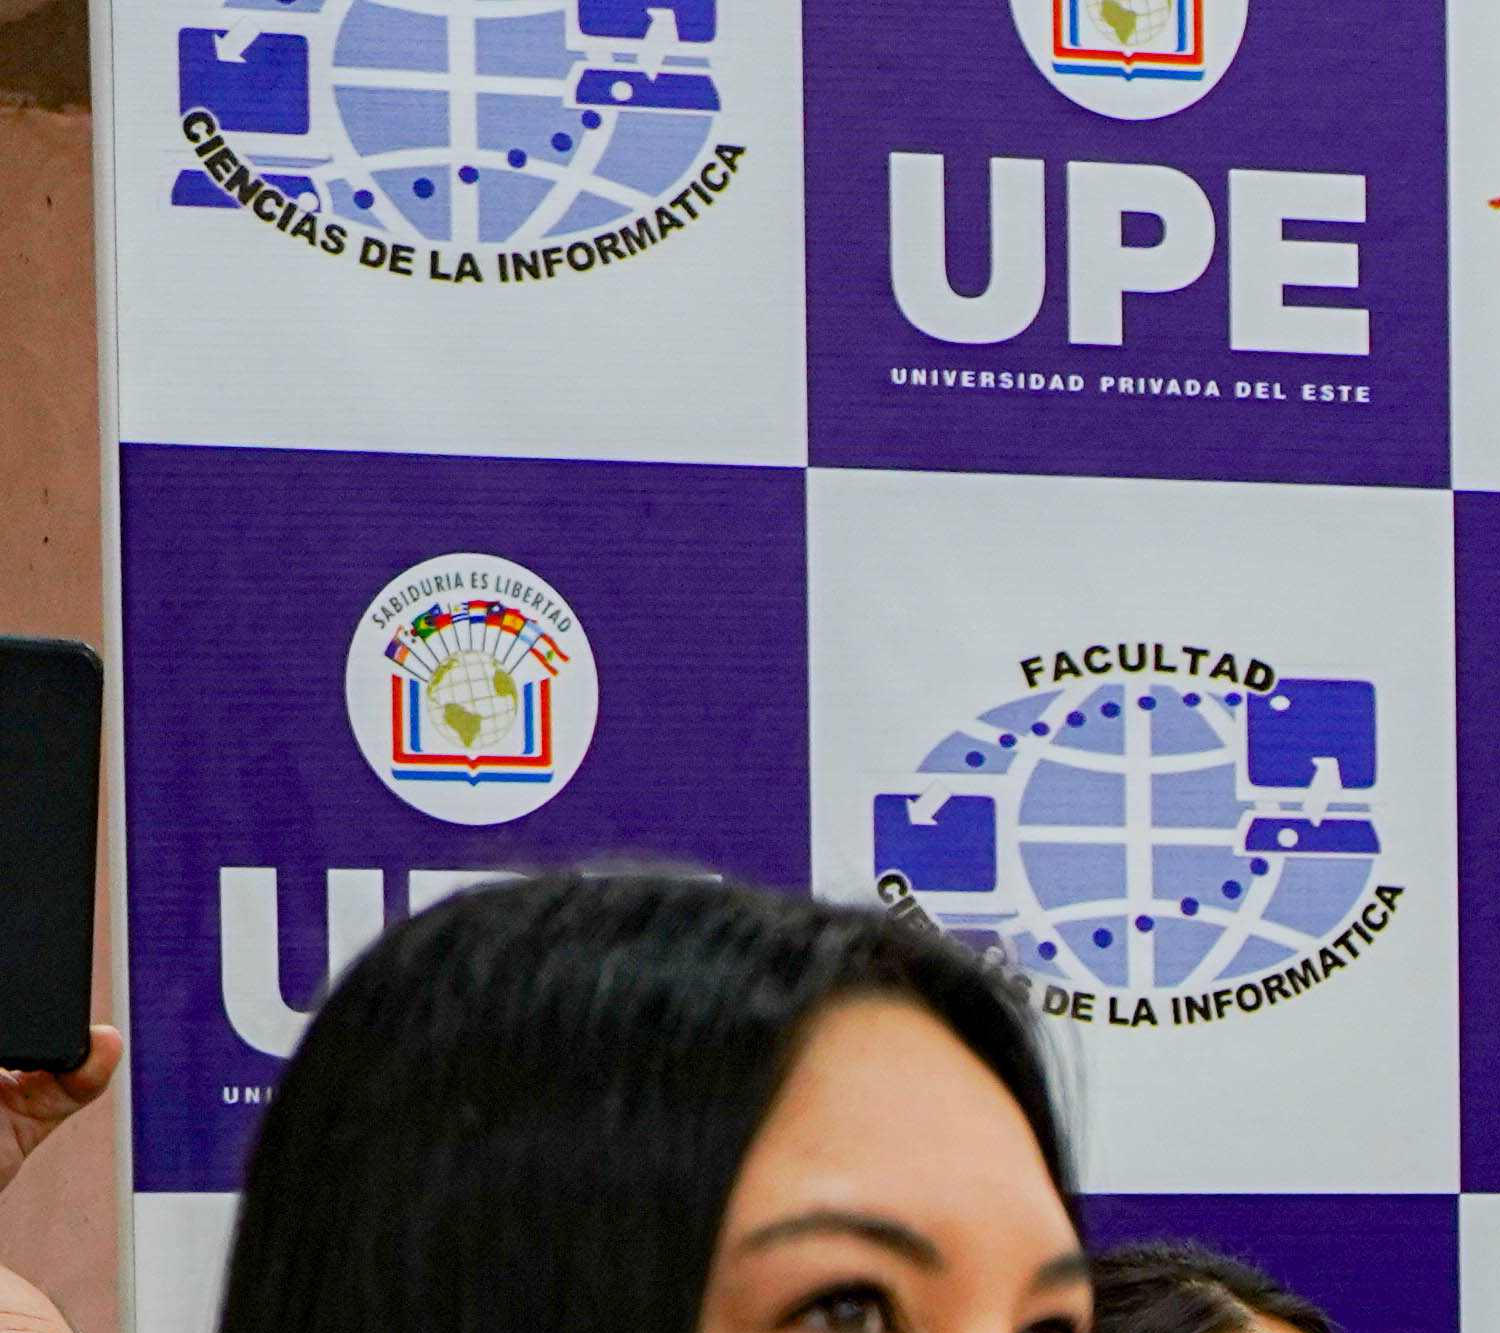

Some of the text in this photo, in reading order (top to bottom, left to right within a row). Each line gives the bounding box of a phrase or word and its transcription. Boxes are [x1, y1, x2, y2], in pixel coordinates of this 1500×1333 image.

[181, 109, 747, 284] CIENCIAS DE LA INFORMATICA
[889, 151, 1370, 356] UPE
[891, 367, 1371, 403] UNIVERSIDAD PRIVADA DEL ESTE
[372, 571, 571, 633] SABIDURIA ES LIBERTAD
[1020, 642, 1276, 693] FACULTAD
[1042, 881, 1405, 1027] DE LA INFORMATICA
